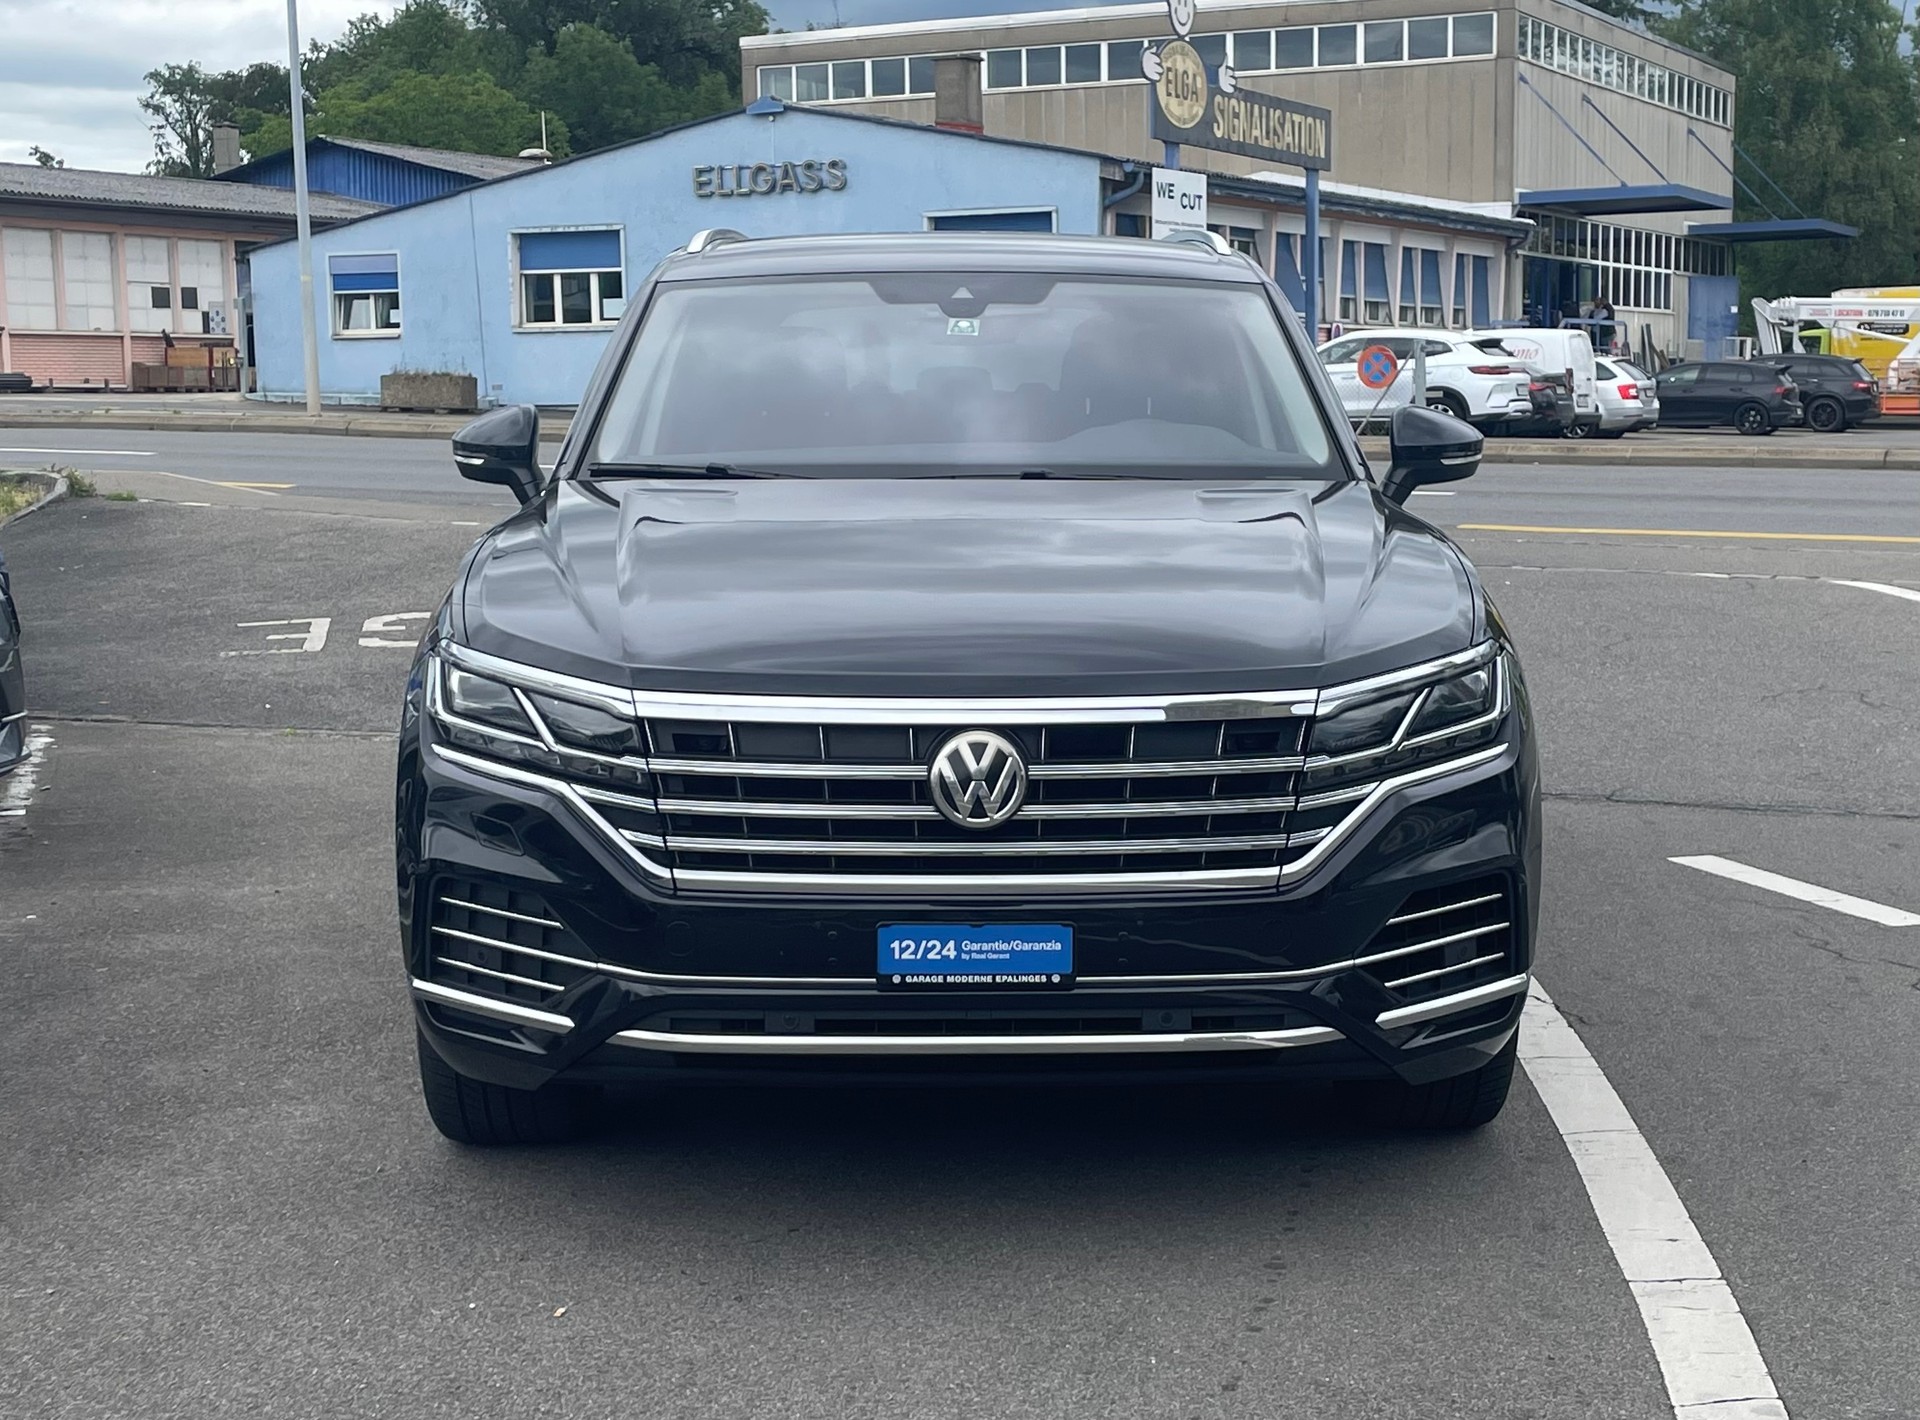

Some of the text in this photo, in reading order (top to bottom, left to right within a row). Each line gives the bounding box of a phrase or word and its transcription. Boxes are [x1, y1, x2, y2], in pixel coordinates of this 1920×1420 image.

[1165, 67, 1199, 102] ELGA
[1212, 94, 1326, 159] SIGNALISATION
[692, 158, 847, 197] ELLGASS
[1156, 181, 1203, 211] WE CUT
[889, 939, 1062, 960] 12/24 Garantie/Garanzia
[905, 974, 1048, 983] GARAGE MODERNE EPALINGES
